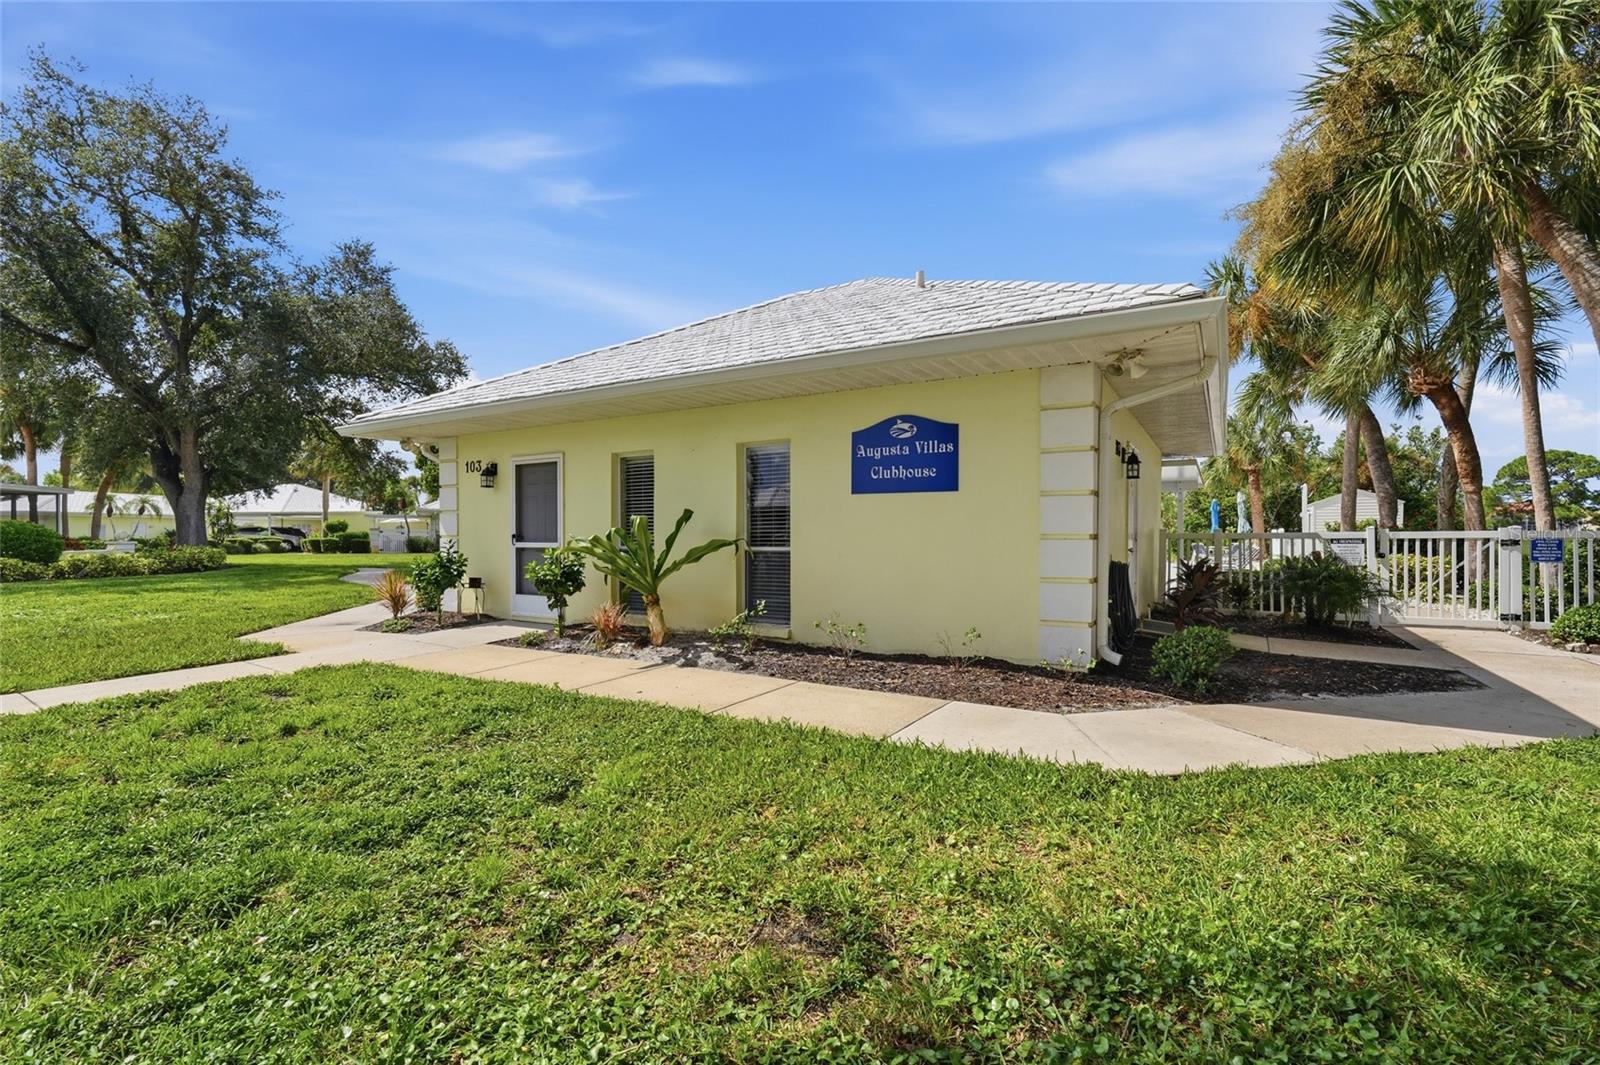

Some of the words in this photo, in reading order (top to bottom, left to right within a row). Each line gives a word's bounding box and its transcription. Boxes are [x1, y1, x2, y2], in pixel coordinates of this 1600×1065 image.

[857, 445, 910, 459] Augusta
[915, 440, 954, 454] Villas
[465, 460, 481, 473] 103
[870, 465, 937, 480] Clubhouse
